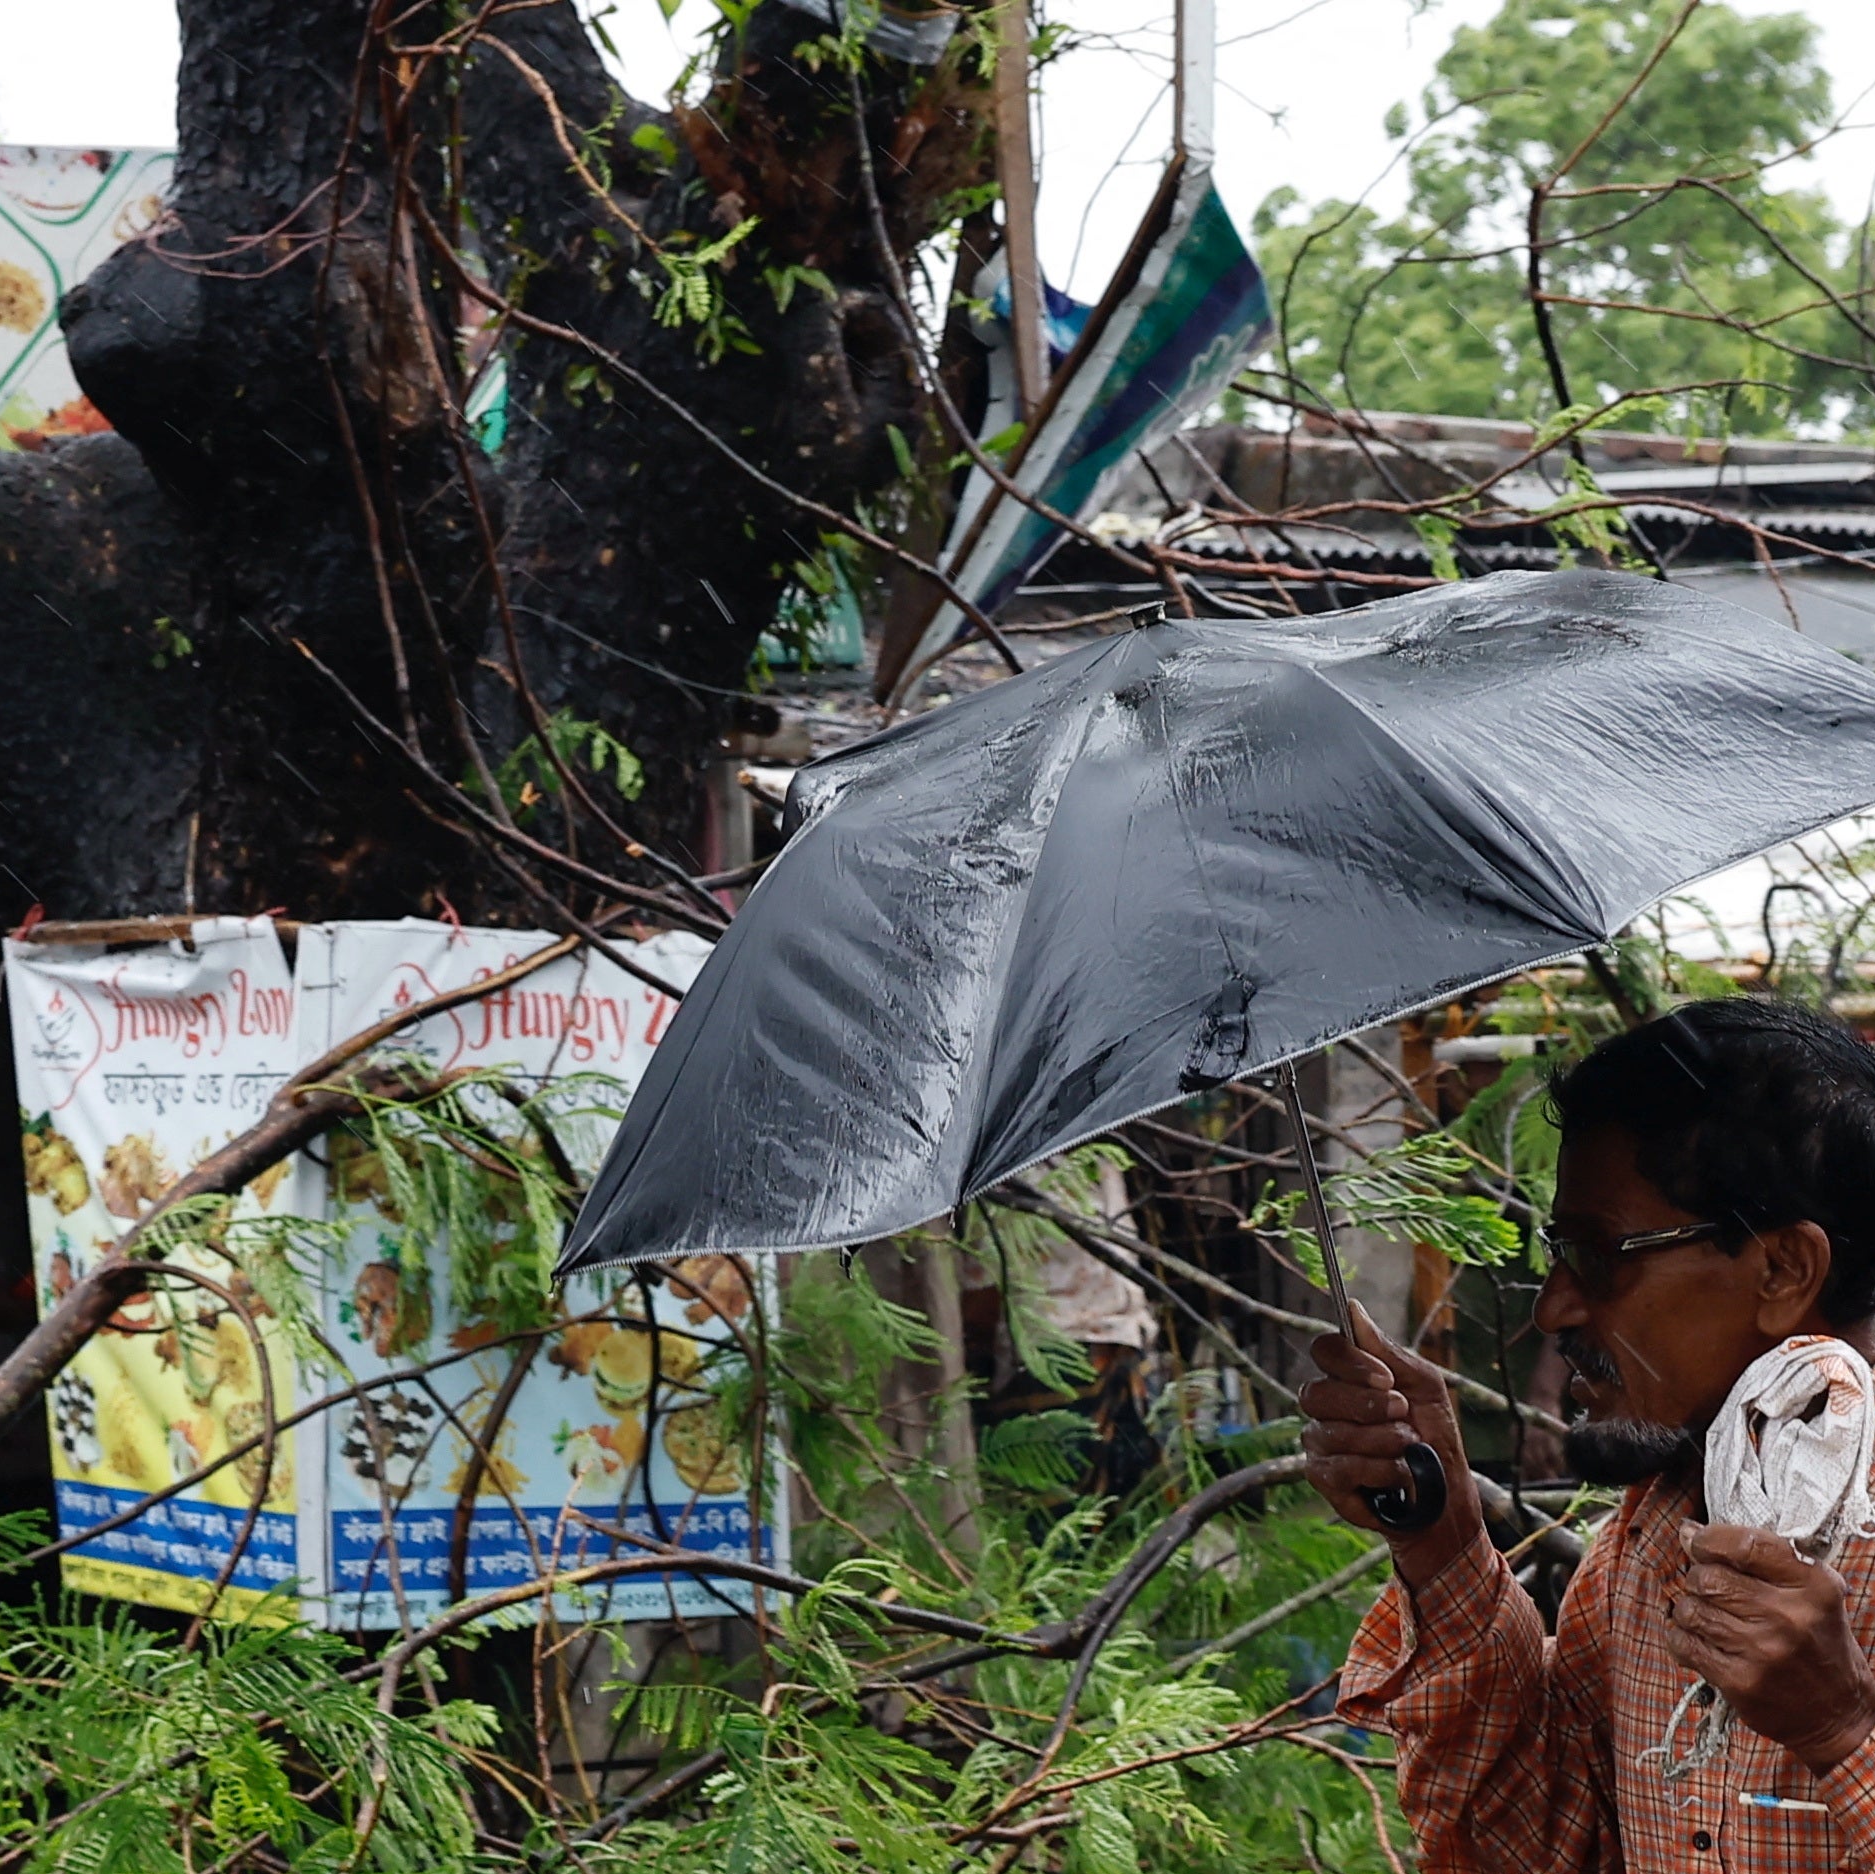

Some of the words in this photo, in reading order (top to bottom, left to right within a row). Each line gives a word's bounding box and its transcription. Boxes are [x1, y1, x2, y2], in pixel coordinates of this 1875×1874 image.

[96, 964, 227, 1058] Hungry
[229, 968, 294, 1042] Zon
[468, 953, 628, 1062] Hungry
